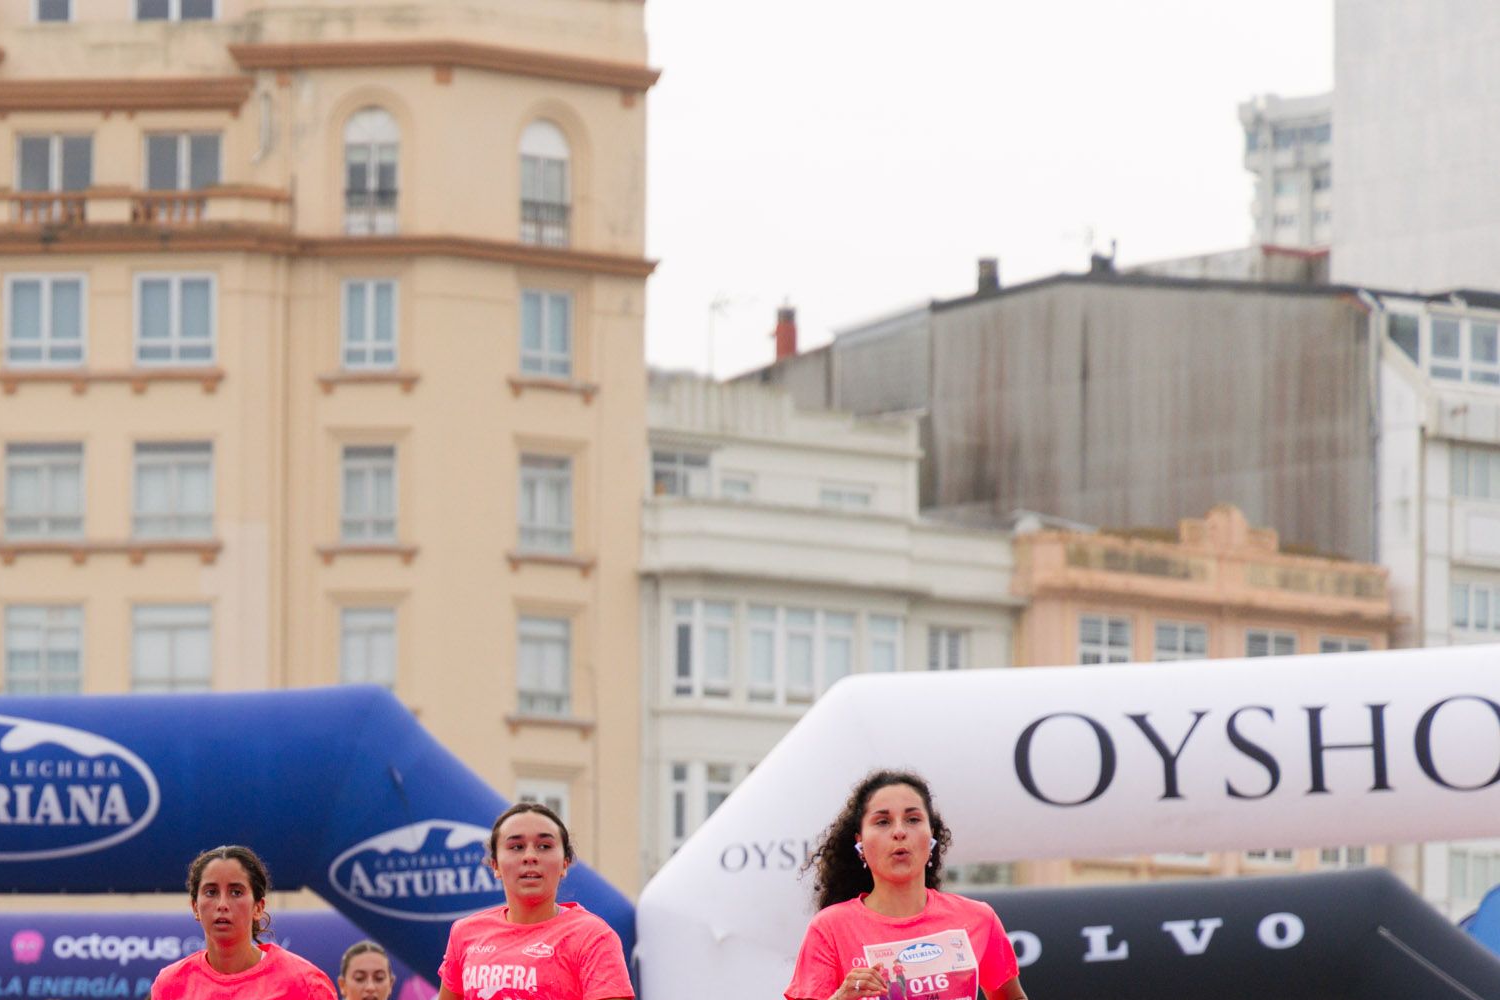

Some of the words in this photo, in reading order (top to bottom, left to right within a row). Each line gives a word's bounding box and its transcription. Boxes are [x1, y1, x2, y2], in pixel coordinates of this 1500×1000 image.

[1013, 694, 1500, 808] OYSHO
[10, 758, 121, 778] LECHERA
[352, 860, 503, 898] ASTURIA
[53, 932, 181, 965] octopus
[902, 949, 941, 961] ASTURIANA
[27, 973, 130, 998] ENERGÍA
[463, 964, 538, 993] CARRERA
[910, 974, 949, 994] 016
